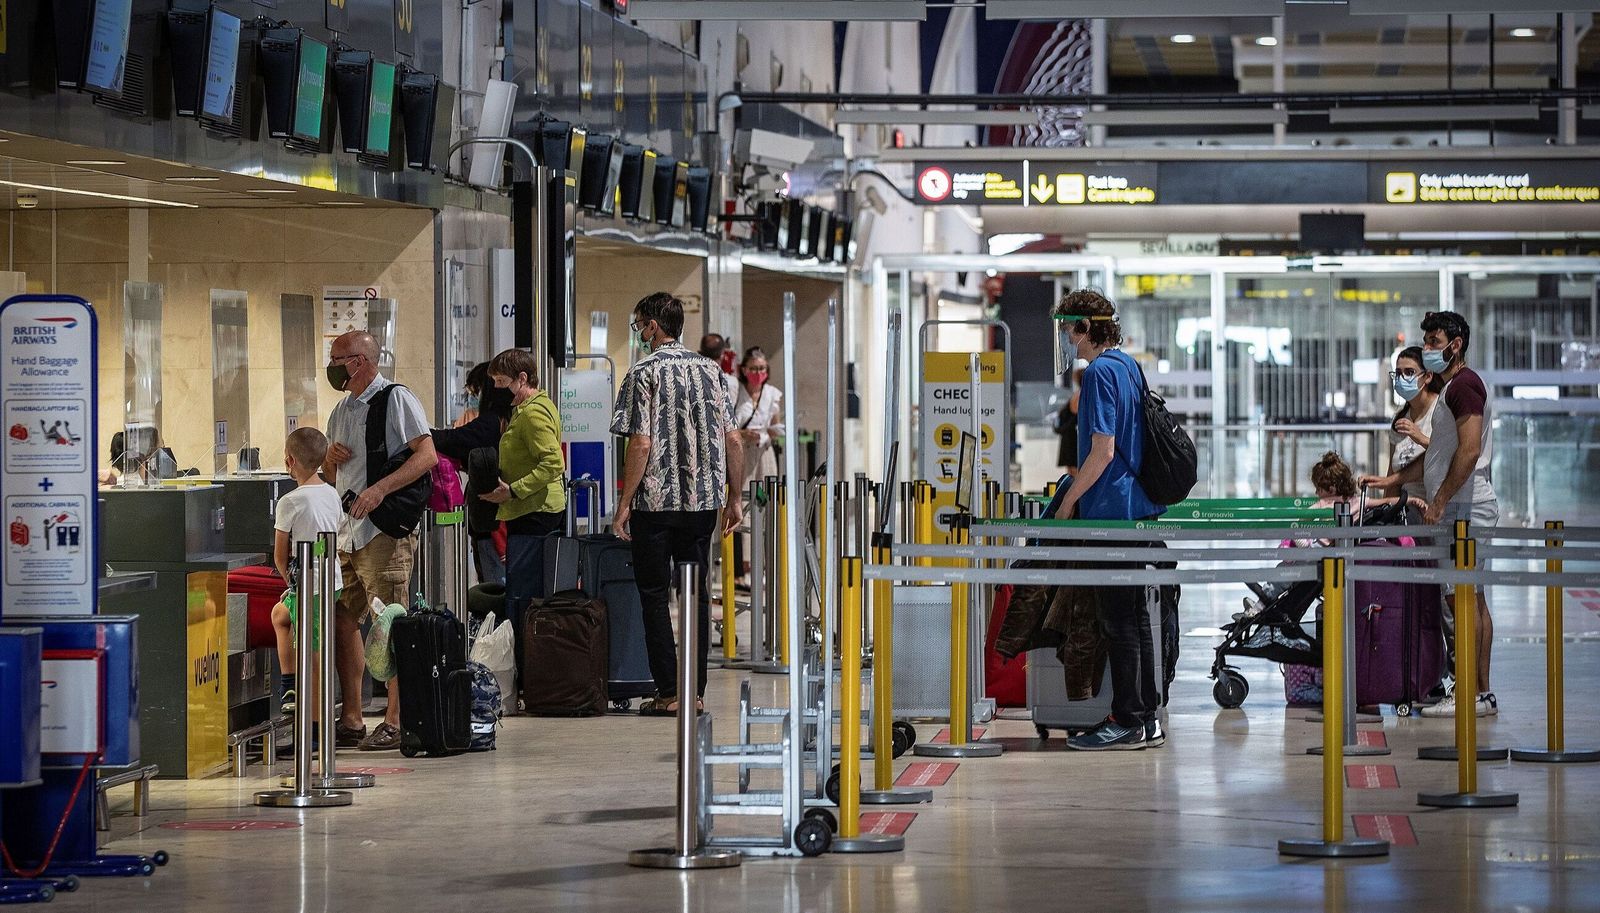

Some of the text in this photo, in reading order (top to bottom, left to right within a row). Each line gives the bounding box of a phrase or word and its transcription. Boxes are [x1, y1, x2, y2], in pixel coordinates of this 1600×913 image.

[1420, 173, 1530, 189] Only with boarding card
[1473, 187, 1518, 202] tarjeta
[1518, 187, 1535, 201] de
[1535, 185, 1600, 202] embarque
[13, 326, 56, 335] BRITISH
[11, 336, 57, 345] AIRWAYS
[11, 356, 78, 367] Hand Baggage
[21, 367, 69, 377] Allowance
[964, 362, 996, 373] vling
[933, 405, 957, 415] Hand
[194, 638, 221, 693] vueling
